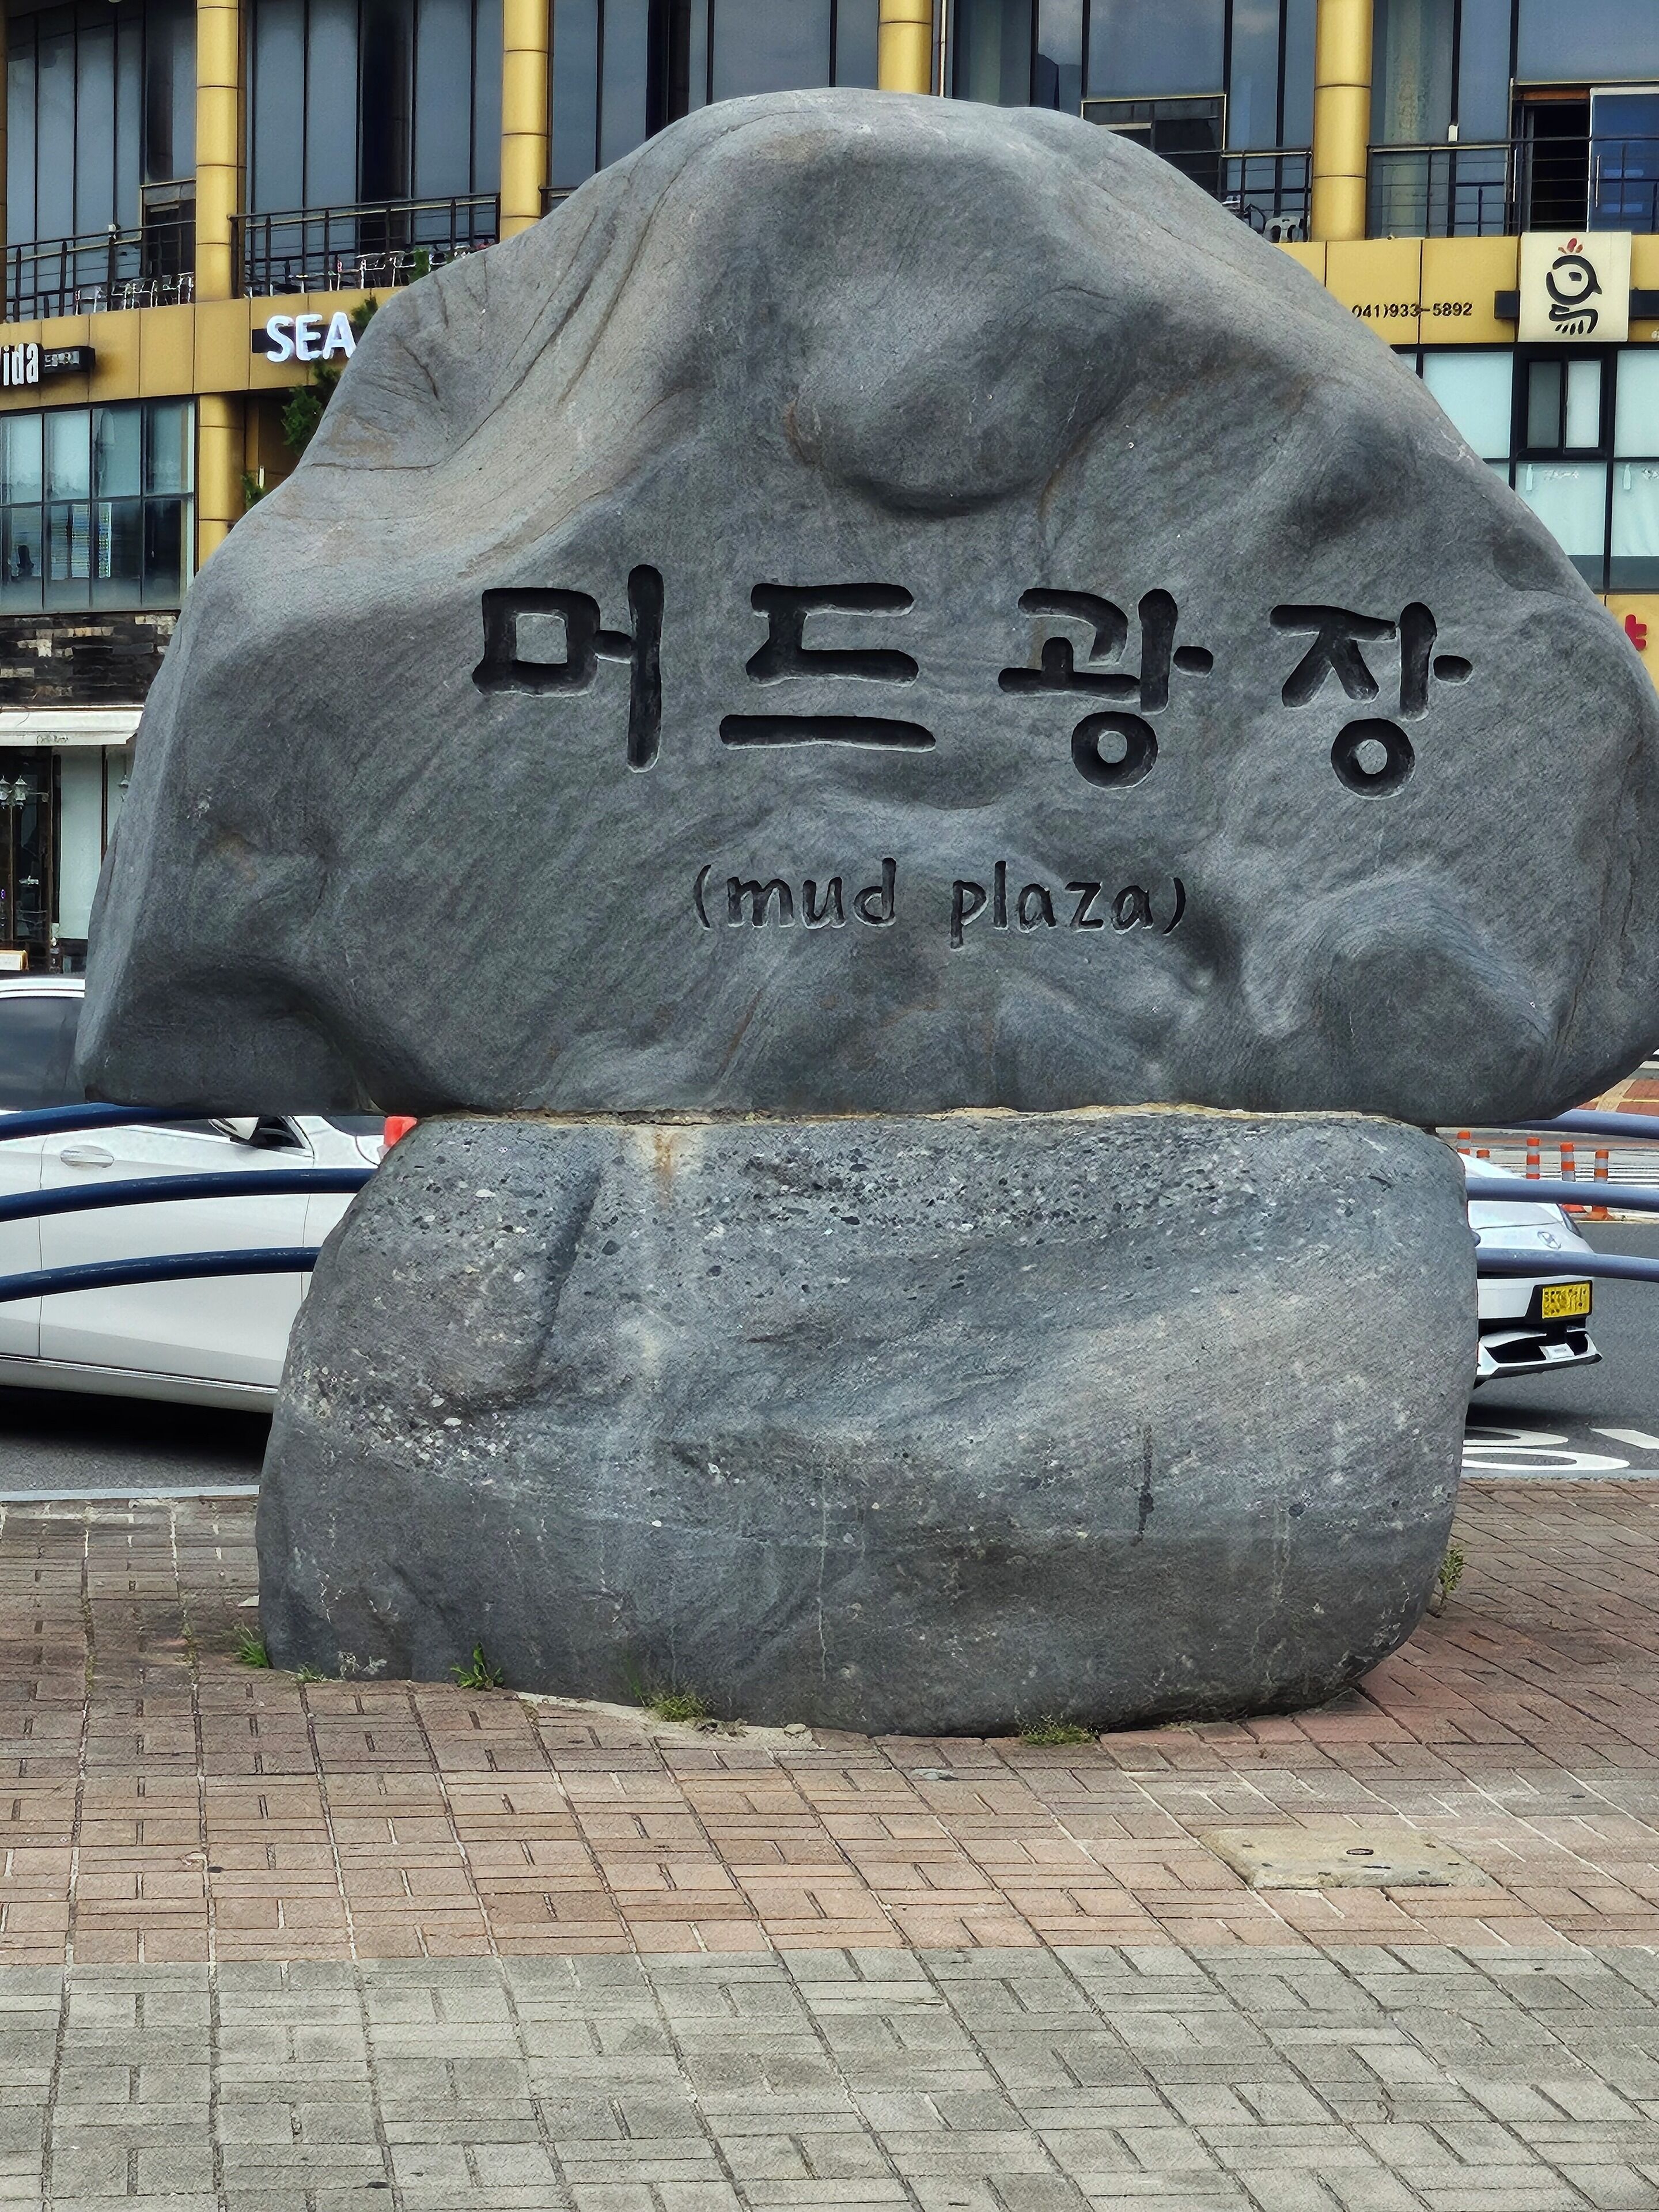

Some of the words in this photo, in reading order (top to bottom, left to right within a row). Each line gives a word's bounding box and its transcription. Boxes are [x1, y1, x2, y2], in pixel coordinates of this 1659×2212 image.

[0, 343, 39, 387] ida
[266, 312, 357, 362] SEA
[471, 564, 1473, 799] 머드광장
[692, 857, 897, 930] (mud
[950, 859, 1187, 950] plaza)
